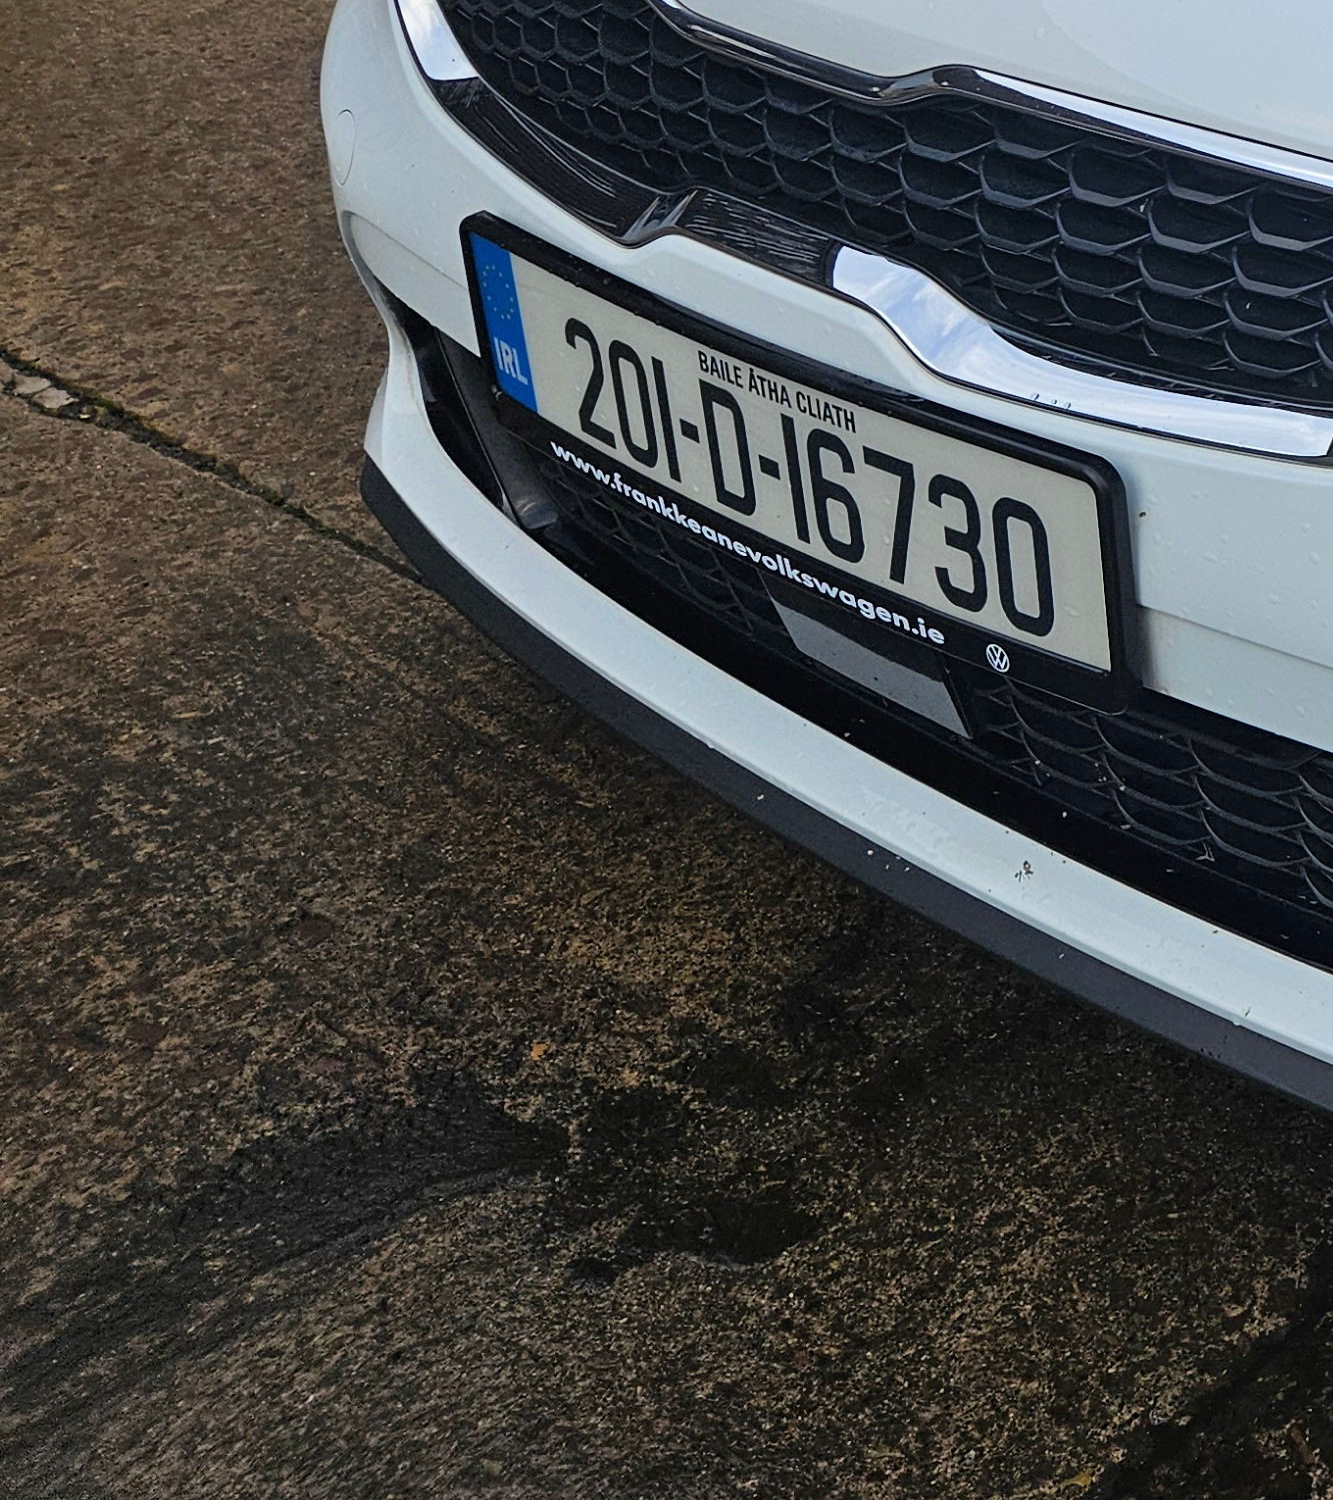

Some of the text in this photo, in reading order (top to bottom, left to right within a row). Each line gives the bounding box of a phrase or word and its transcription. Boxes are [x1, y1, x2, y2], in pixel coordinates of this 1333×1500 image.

[493, 336, 529, 385] IRL
[698, 350, 857, 435] BAILE ÁTHA CLIATH
[549, 439, 946, 647] www.frankkeanevolkswagen.ie
[564, 317, 1054, 638] 201-D-16730
